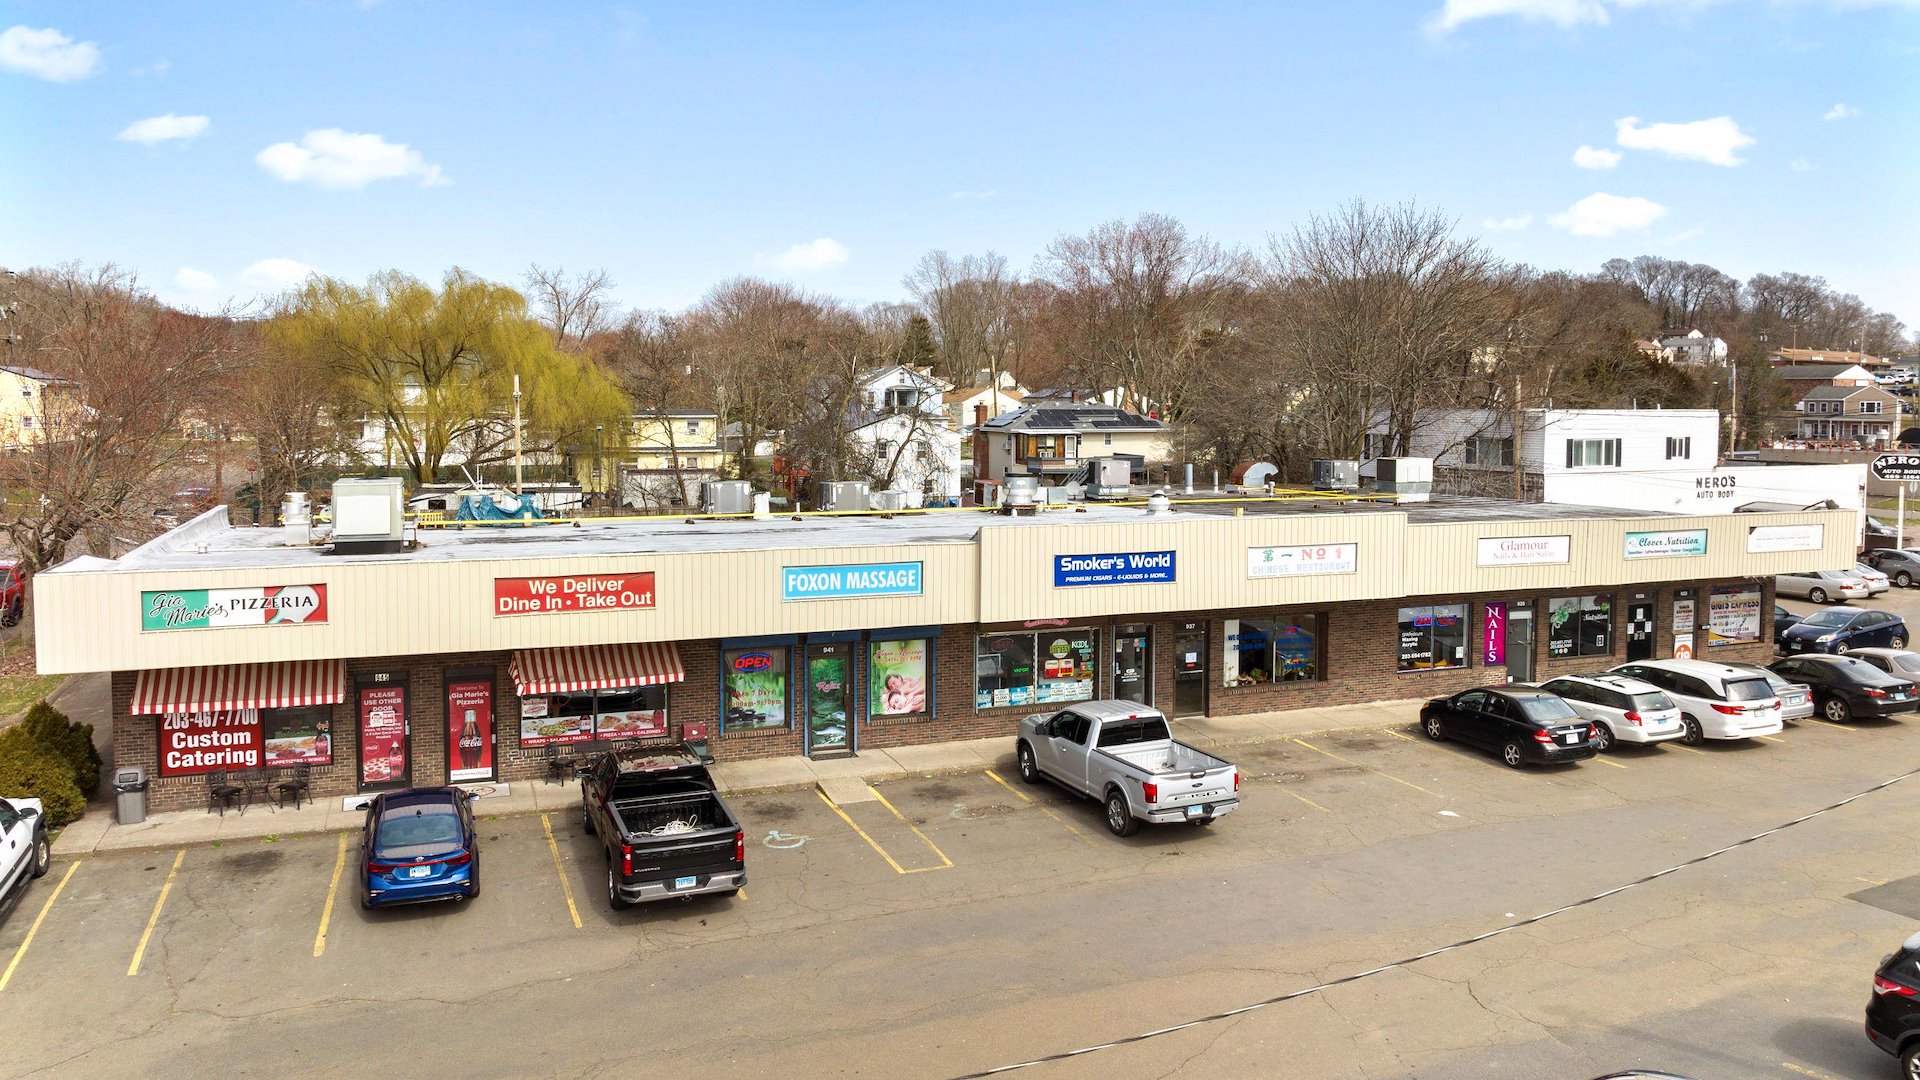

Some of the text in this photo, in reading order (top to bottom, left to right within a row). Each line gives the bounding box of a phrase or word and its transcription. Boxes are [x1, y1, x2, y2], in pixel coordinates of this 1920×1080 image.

[1875, 456, 1920, 469] NERO
[1696, 475, 1736, 488] NERO'S
[1717, 490, 1735, 498] BODY
[1500, 540, 1549, 551] Glamour
[1638, 536, 1699, 547] Clover Nutrition
[1262, 548, 1293, 562] 第一
[1335, 548, 1342, 559] 1
[1060, 553, 1171, 571] Smoker's World
[1252, 561, 1351, 575] CHINESE RESTAURANT
[528, 578, 624, 595] We Deliver
[788, 569, 916, 592] FOXON MASSAGE
[149, 592, 185, 617] Gia
[230, 596, 314, 611] PIZZERIA
[499, 591, 652, 612] Dine In Take Out
[164, 602, 229, 627] Marie's
[1486, 606, 1502, 662] NAILS
[1071, 640, 1089, 648] KOOL
[735, 655, 773, 669] OPEN
[171, 730, 252, 749] Custom
[167, 748, 258, 769] Catering
